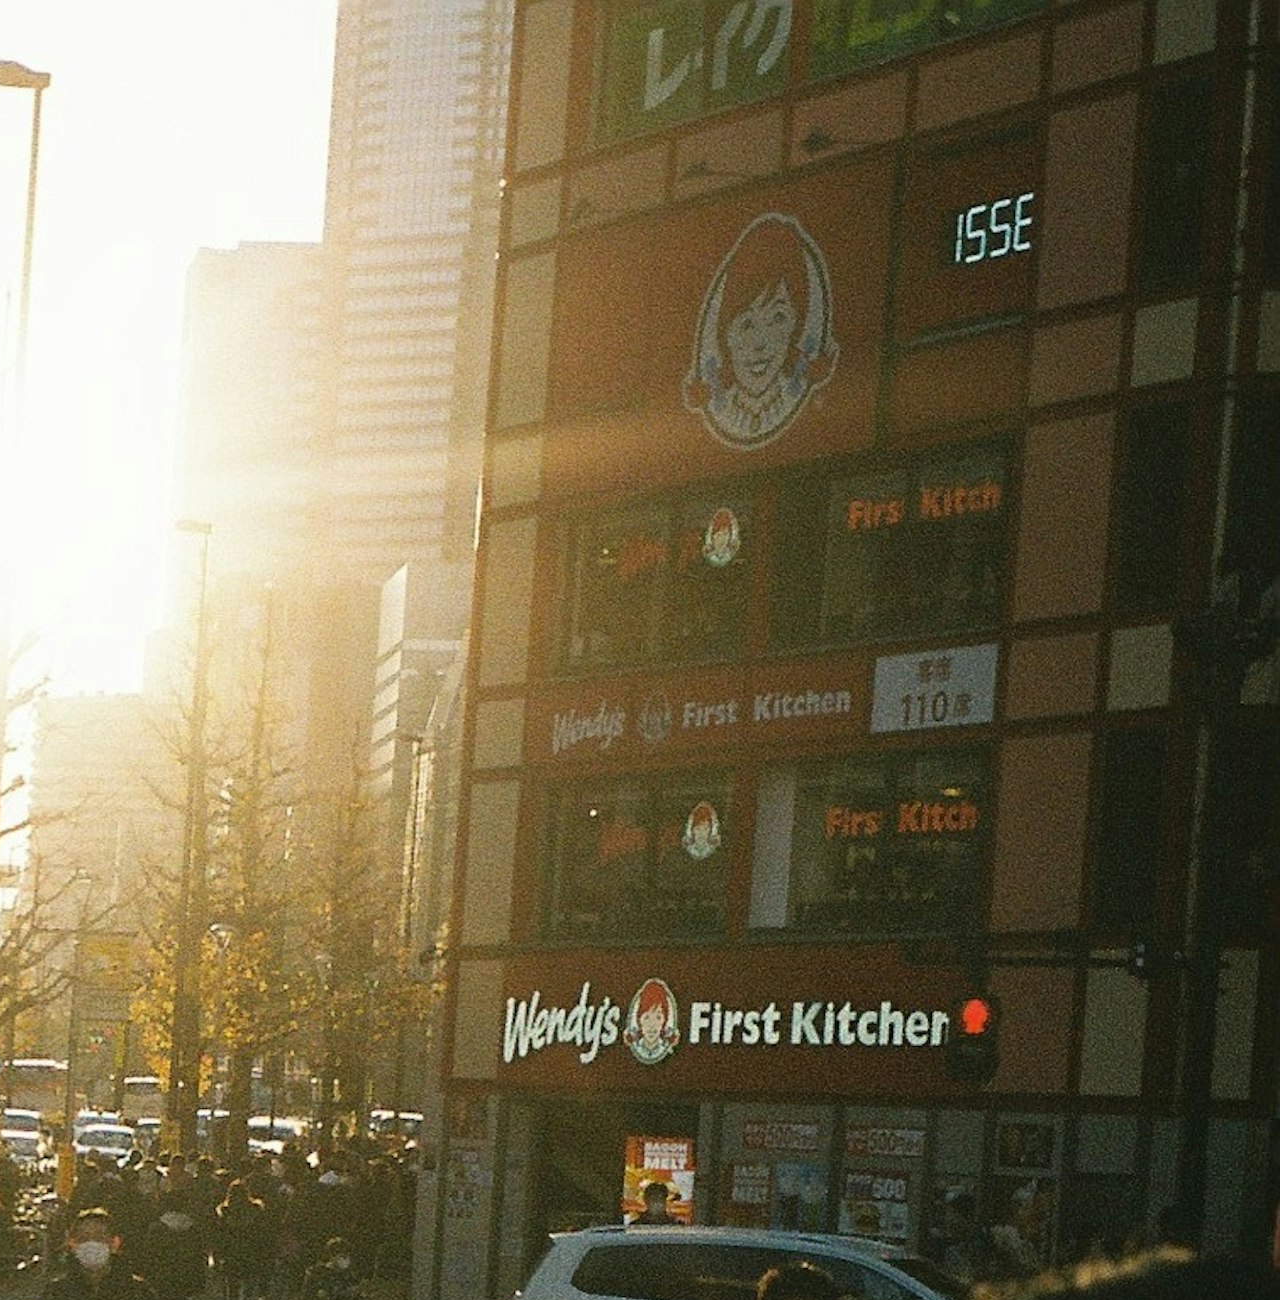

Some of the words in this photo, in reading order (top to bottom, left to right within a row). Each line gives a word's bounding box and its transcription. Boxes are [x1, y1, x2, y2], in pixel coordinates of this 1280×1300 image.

[682, 699, 740, 729] First
[753, 690, 852, 722] Kitchen
[503, 981, 621, 1063] Wendy's
[689, 1001, 781, 1045] First
[644, 1156, 687, 1170] MELT
